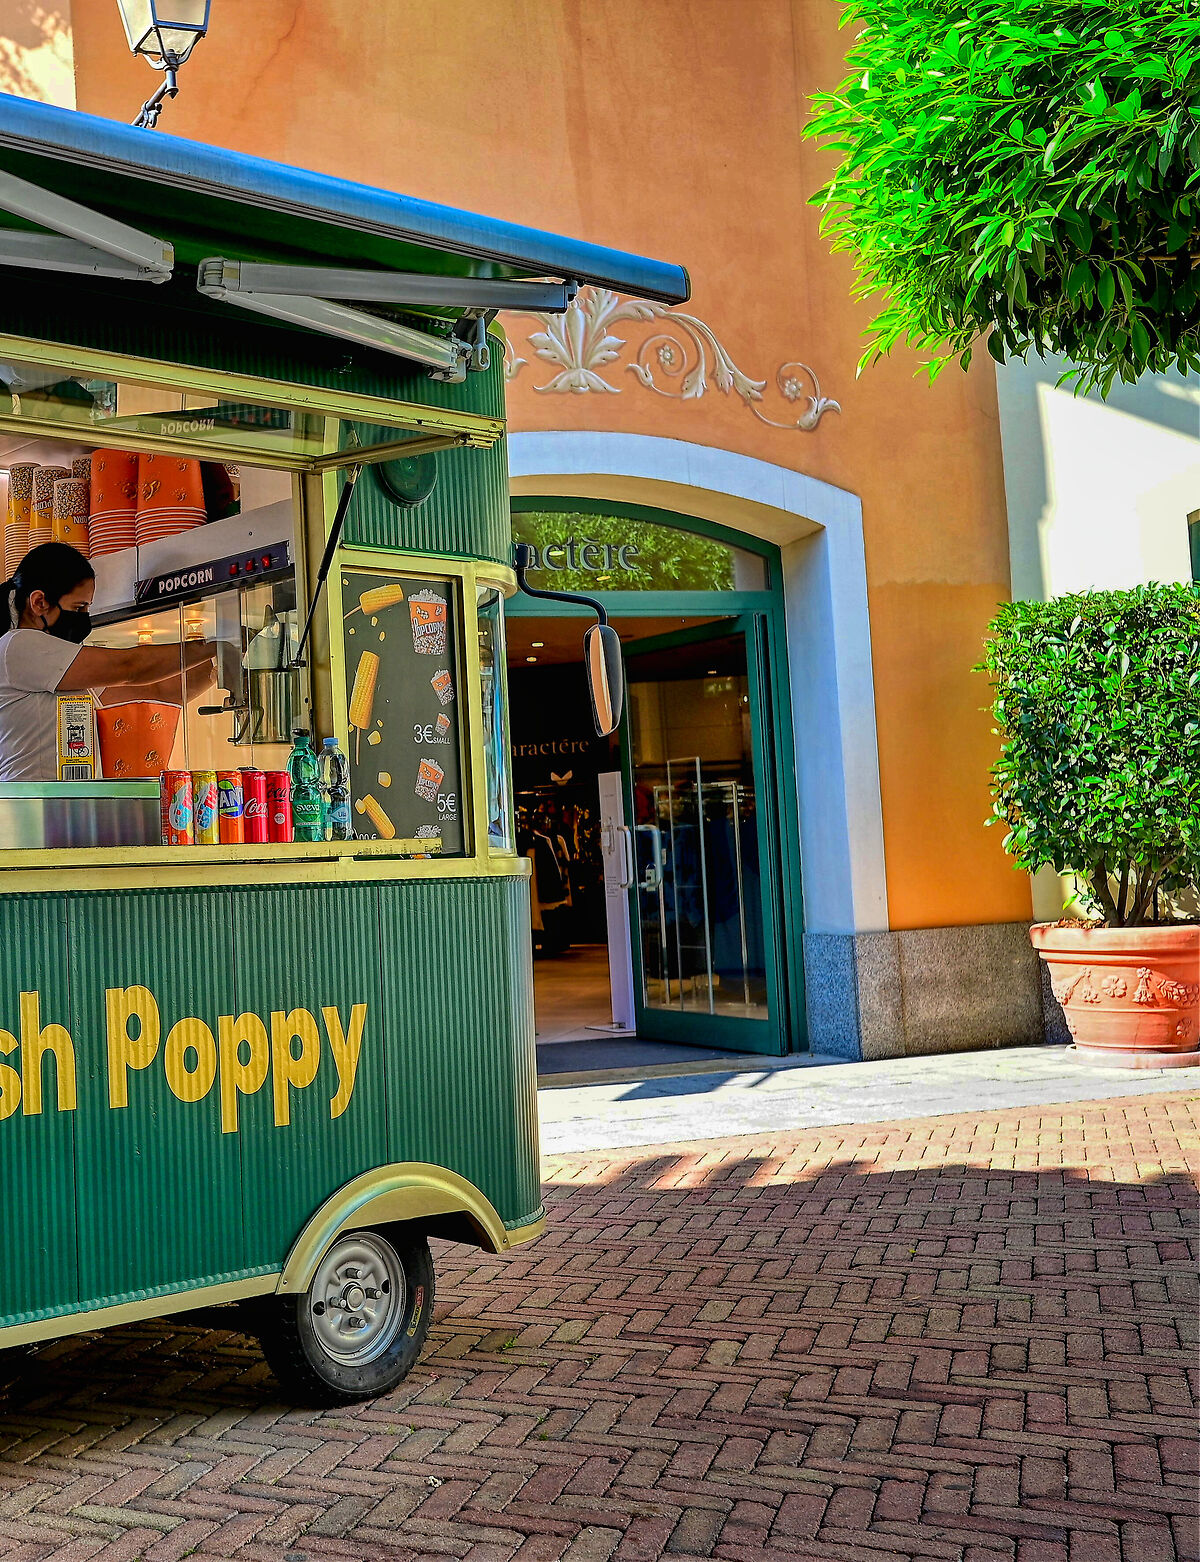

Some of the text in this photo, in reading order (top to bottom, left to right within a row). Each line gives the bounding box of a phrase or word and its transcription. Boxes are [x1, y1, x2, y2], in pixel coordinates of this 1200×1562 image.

[158, 568, 214, 594] POPCORN
[413, 724, 434, 744] 3€
[437, 793, 456, 812] 5€
[438, 813, 458, 821] LARGE
[105, 984, 368, 1133] Poppy
